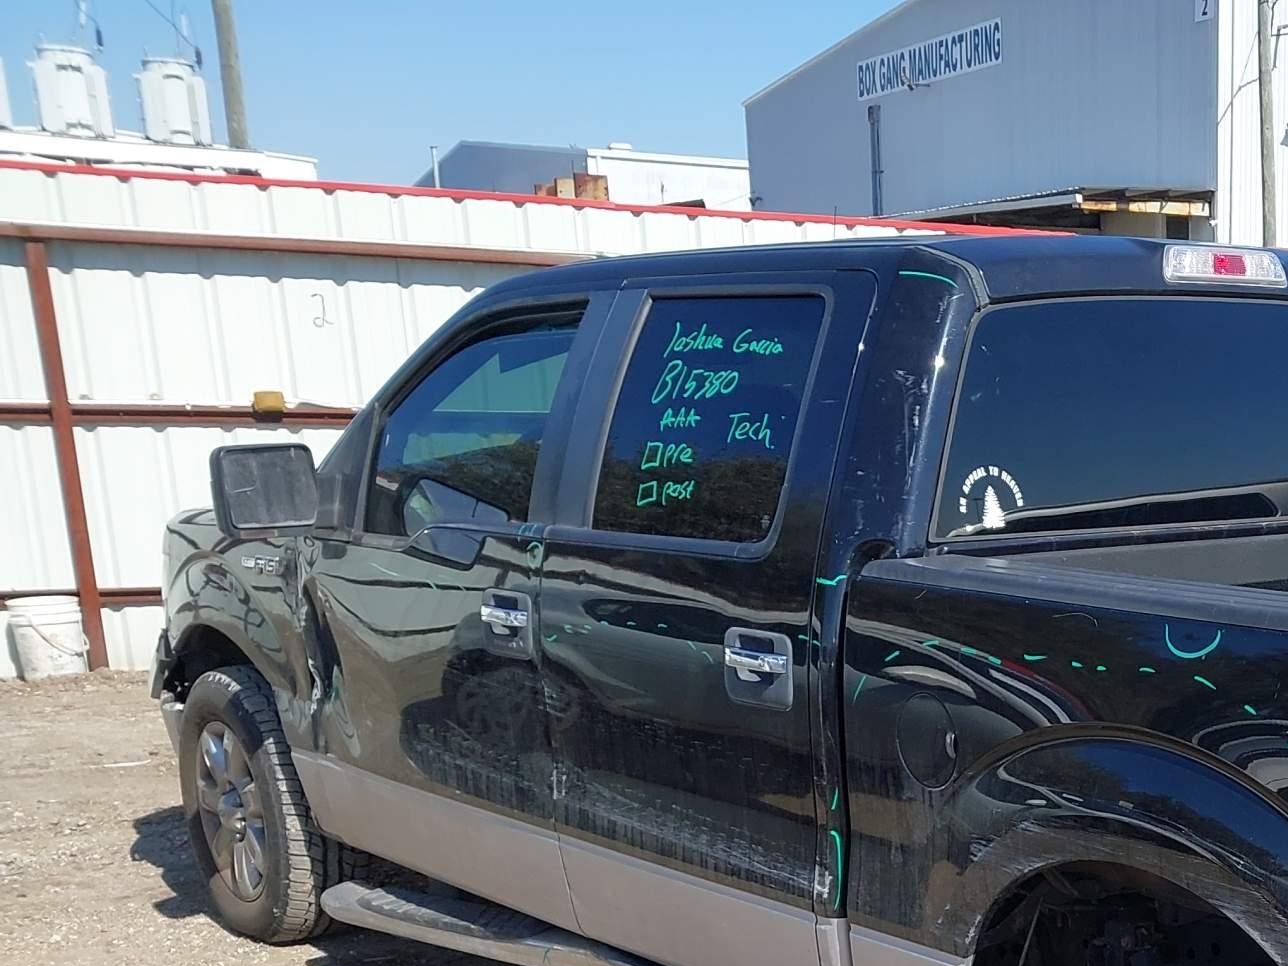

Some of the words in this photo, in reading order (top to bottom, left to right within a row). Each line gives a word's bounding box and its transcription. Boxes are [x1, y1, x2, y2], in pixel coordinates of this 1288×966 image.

[857, 61, 878, 98] BOX
[879, 52, 906, 92] GANG
[908, 21, 1001, 84] MANUFACTURING
